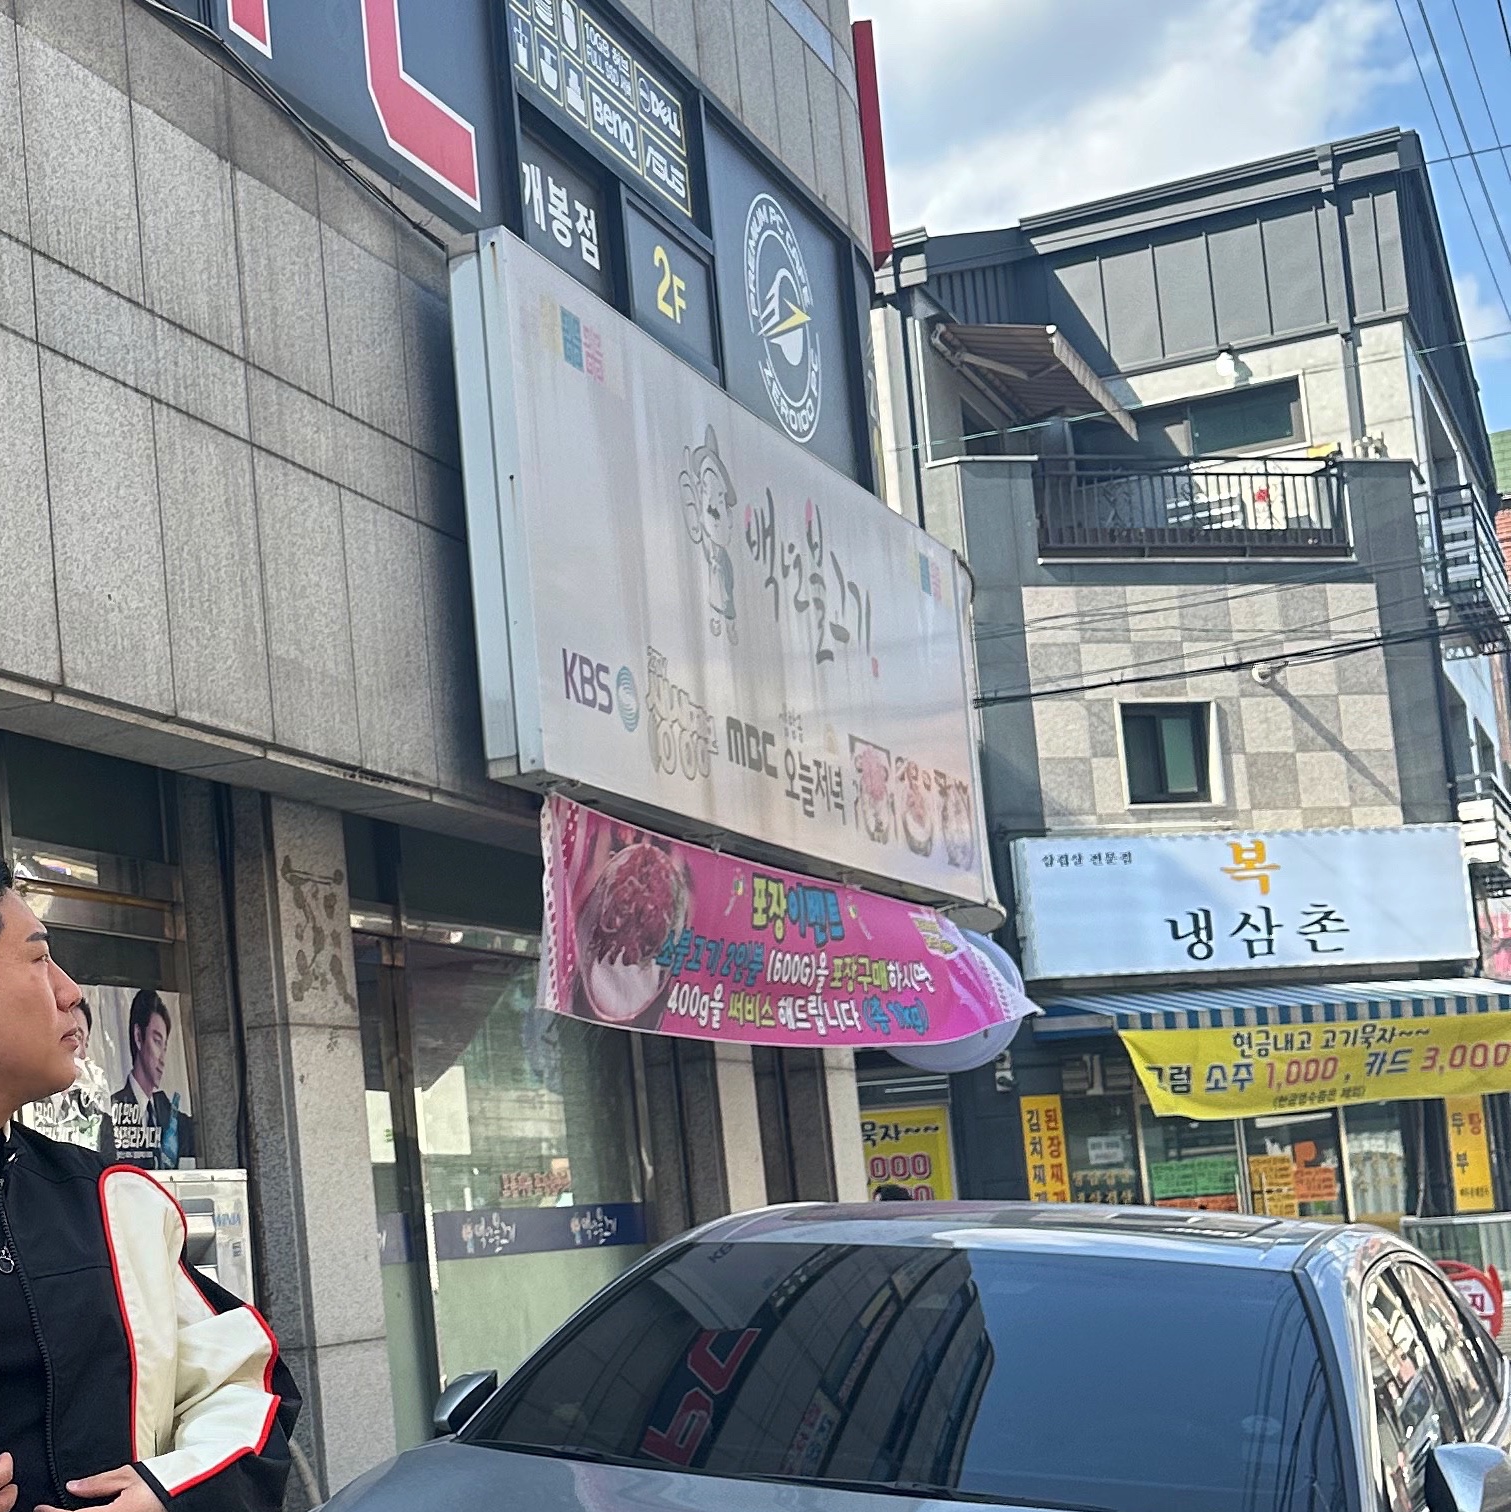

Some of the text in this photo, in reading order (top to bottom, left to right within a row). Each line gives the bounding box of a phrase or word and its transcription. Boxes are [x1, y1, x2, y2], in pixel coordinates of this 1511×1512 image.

[521, 162, 601, 271] 개봉점
[653, 245, 686, 324] 2F
[561, 648, 613, 715] KBS
[726, 716, 778, 779] MBC
[1220, 838, 1281, 895] 복
[667, 982, 725, 1030] 400g을
[1205, 1062, 1255, 1093] 소주
[1364, 1048, 1414, 1079] 카드
[1231, 1029, 1313, 1059] 현금내고
